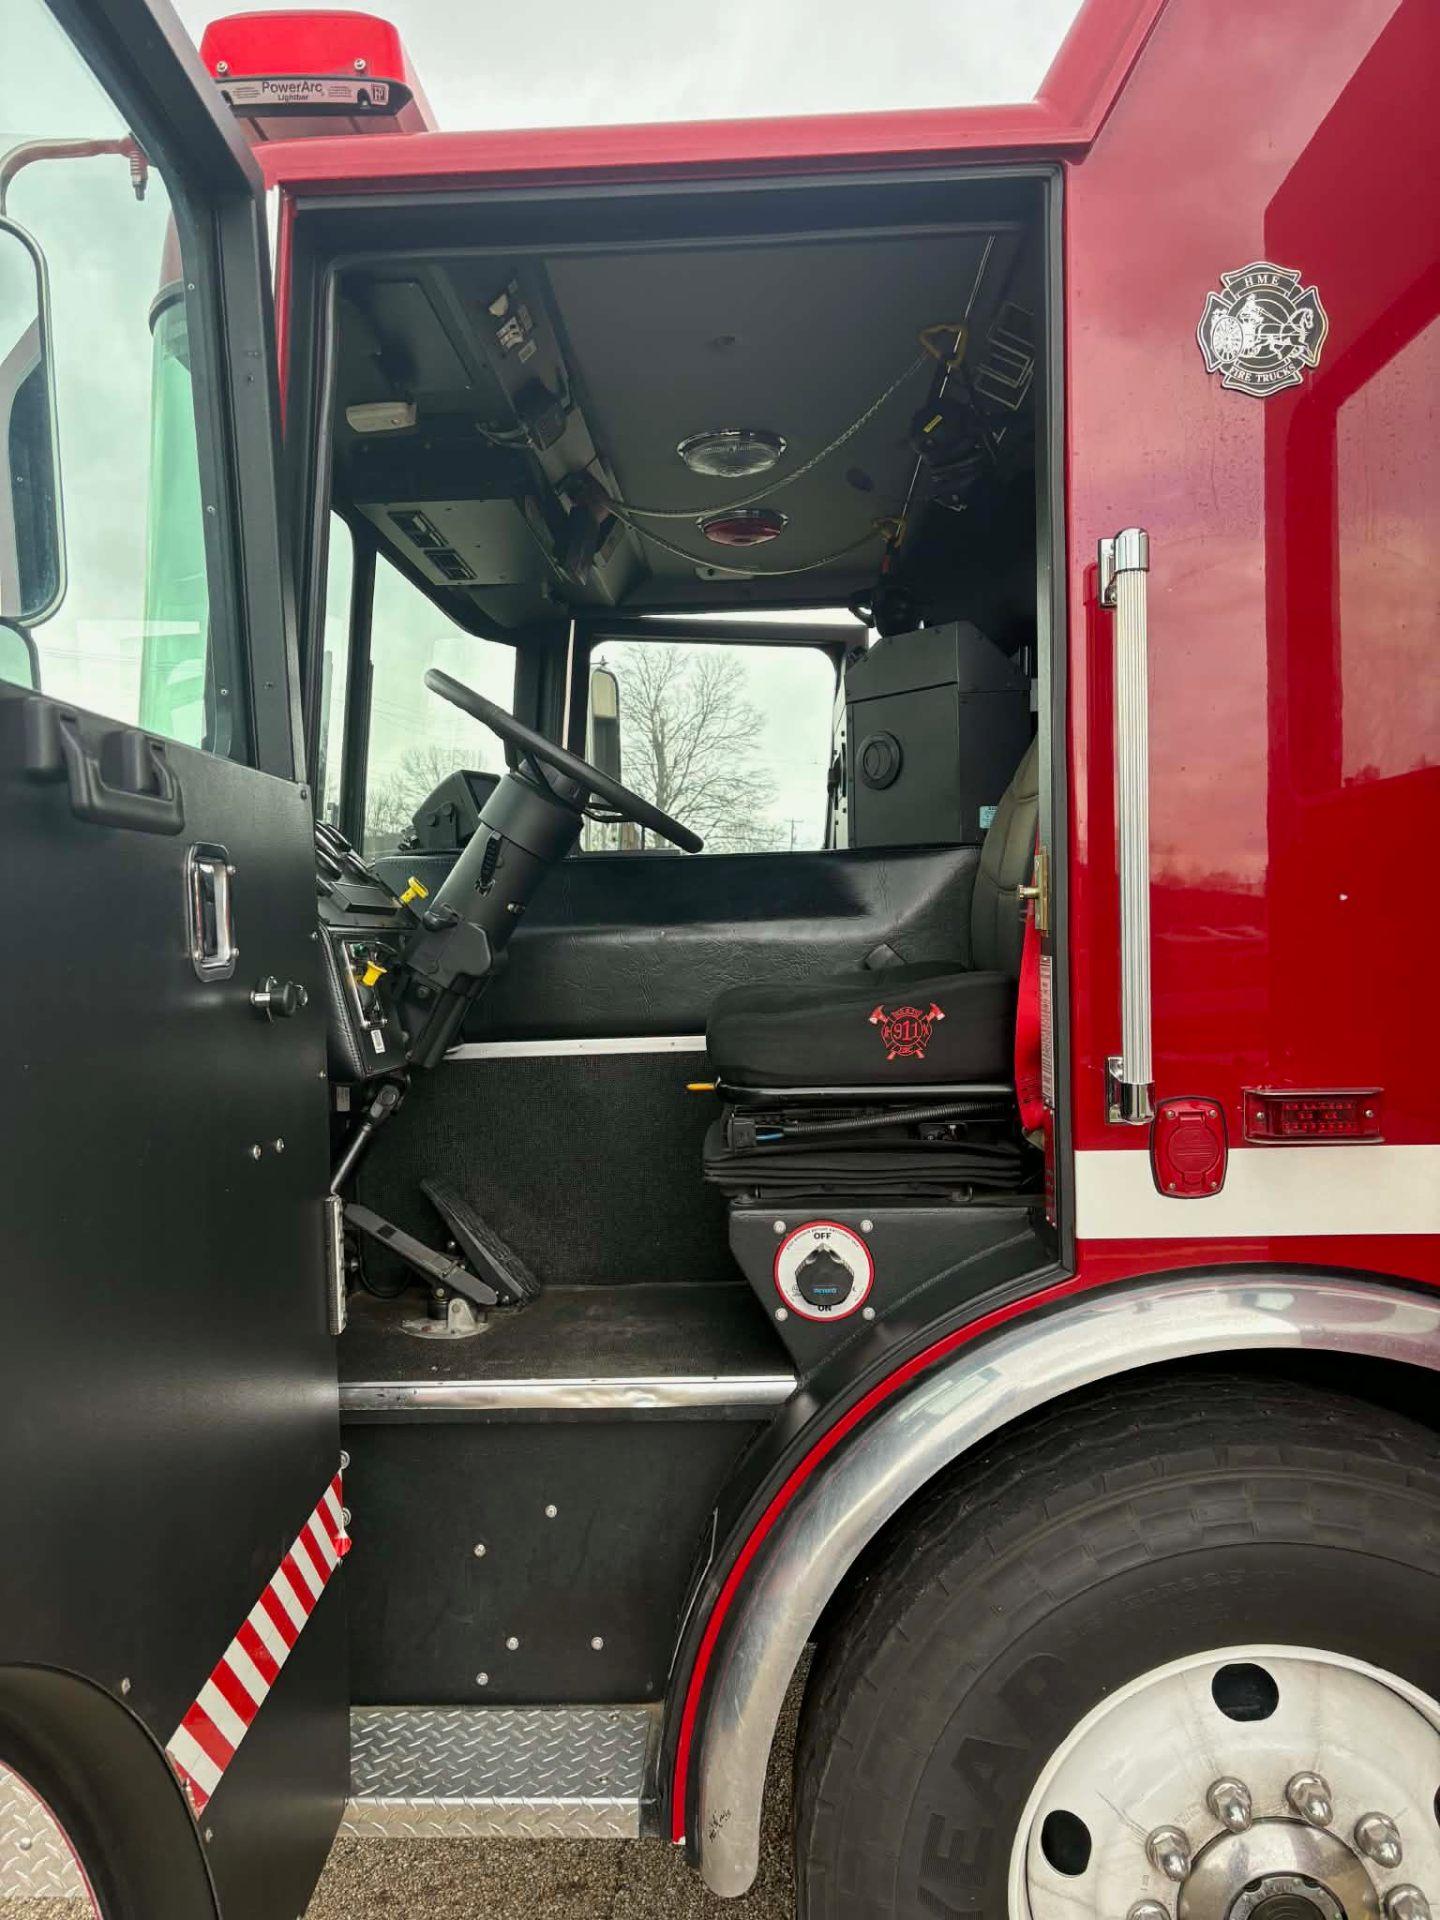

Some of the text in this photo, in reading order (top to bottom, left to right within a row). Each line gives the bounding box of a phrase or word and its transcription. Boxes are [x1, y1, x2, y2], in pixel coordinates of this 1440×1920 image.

[261, 81, 322, 94] PowerArc
[1245, 274, 1280, 287] HME
[1229, 363, 1297, 383] FIRE TRUCKS
[894, 1020, 920, 1042] 911
[813, 1232, 832, 1240] OFF
